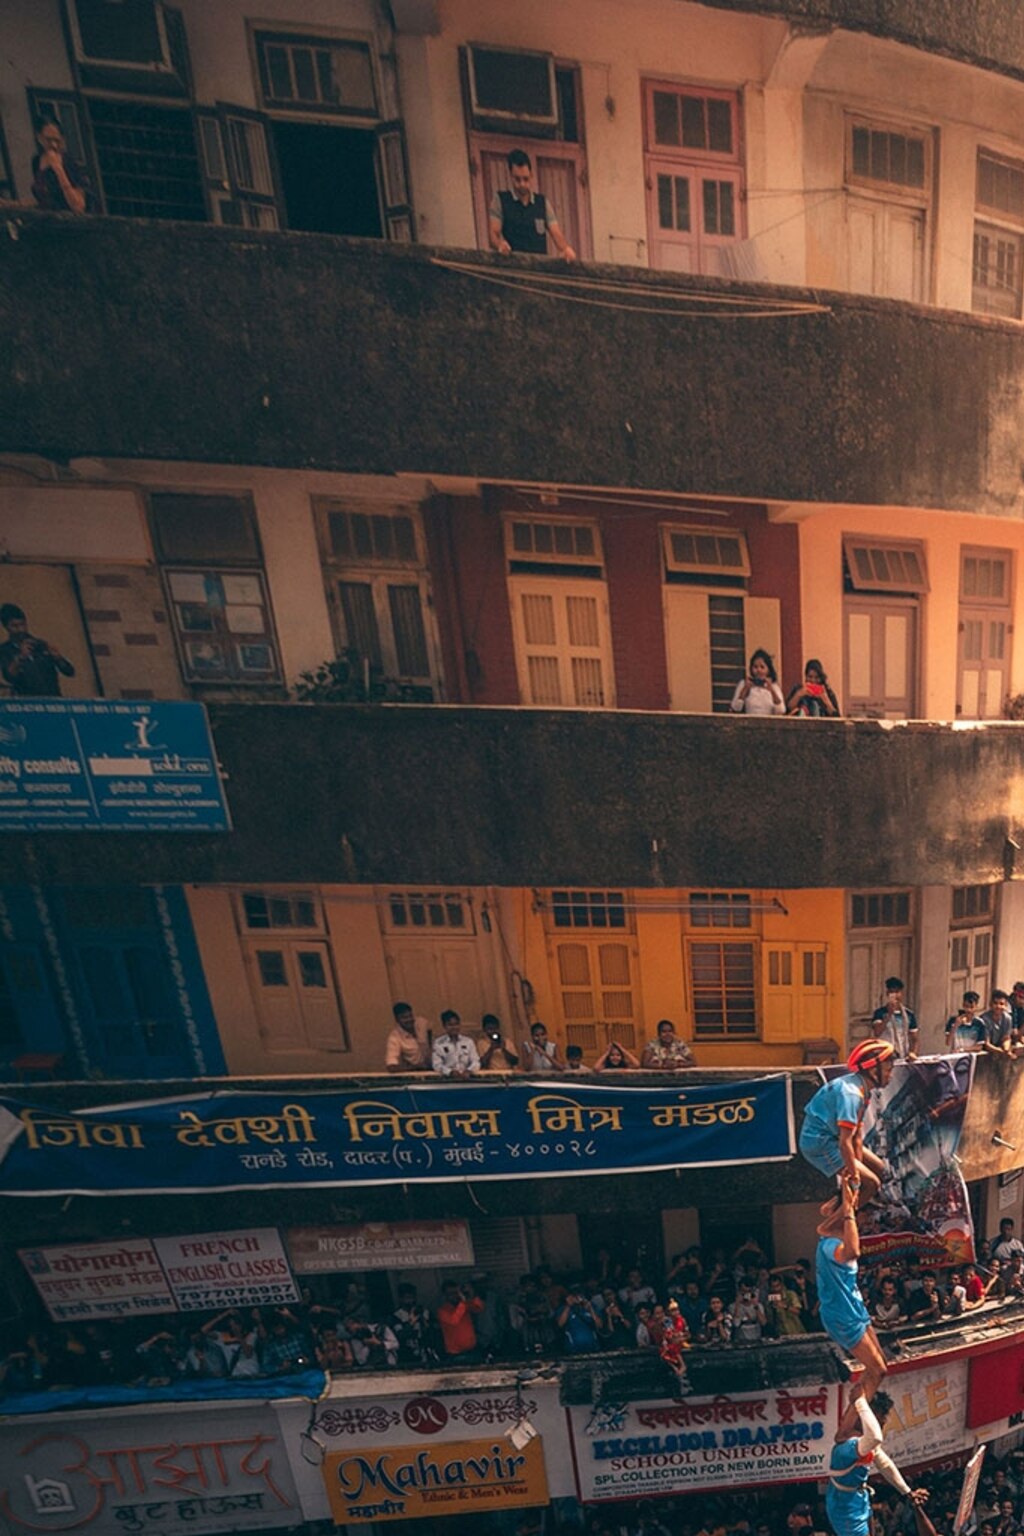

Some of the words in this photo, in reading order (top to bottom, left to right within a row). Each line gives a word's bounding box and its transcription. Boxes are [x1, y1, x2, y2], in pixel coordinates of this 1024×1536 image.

[171, 1102, 317, 1149] देवशी
[343, 1100, 501, 1143] निवास
[527, 1094, 624, 1135] मित्र
[648, 1094, 757, 1129] मंडळ
[239, 1150, 288, 1171] रानडे
[443, 1141, 485, 1168] मुंबई
[506, 1140, 598, 1160] ४०००२८
[180, 1237, 261, 1258] FRENCH
[318, 1236, 366, 1252] NKGSB
[51, 1248, 157, 1273] योगायोग
[168, 1261, 226, 1284] ENGLISH
[228, 1258, 288, 1279] CLASSES
[882, 1377, 952, 1441] ALE
[592, 1427, 718, 1460] EXCELSIOR
[722, 1422, 824, 1449] DRAPERS
[611, 1452, 697, 1472] SCHOOL
[703, 1441, 809, 1462] UNIFORMS
[338, 1446, 526, 1500] Mahavir
[700, 1463, 724, 1475] FOR
[728, 1461, 755, 1472] NEW
[757, 1457, 790, 1469] BORN
[793, 1454, 825, 1465] BABY
[0, 1432, 291, 1531] आझाद
[347, 1499, 406, 1519] महावीर
